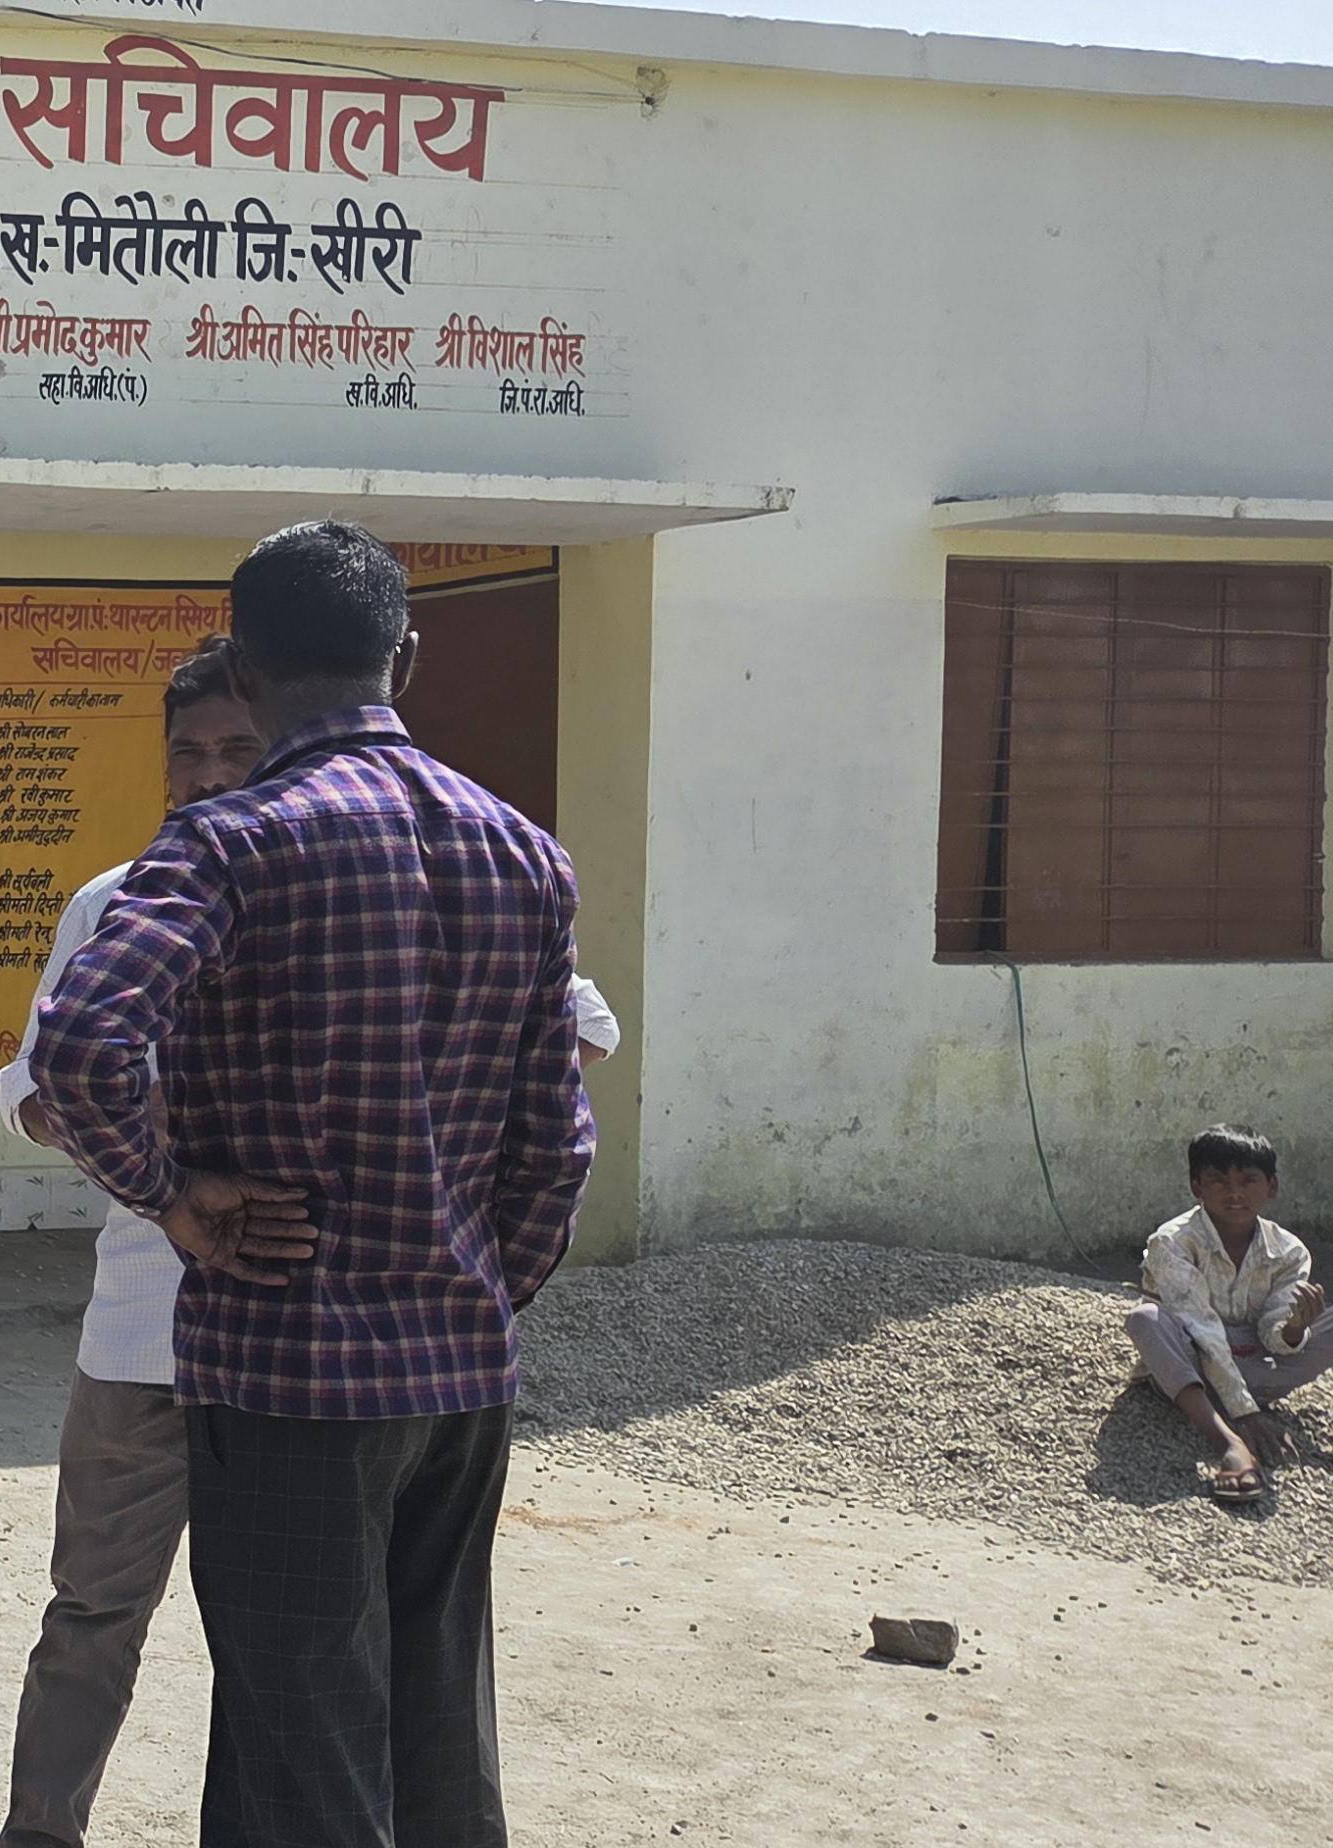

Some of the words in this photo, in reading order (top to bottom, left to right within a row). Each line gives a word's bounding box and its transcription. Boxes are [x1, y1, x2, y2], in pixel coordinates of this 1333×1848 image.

[1, 35, 505, 182] सचिवालय
[10, 300, 84, 360] प्रमोद
[79, 317, 152, 367] कुमार
[186, 303, 219, 361] श्री
[217, 305, 287, 369] अमित
[287, 308, 334, 371] सिंह
[334, 309, 416, 374] परिहार
[435, 312, 467, 369] श्री
[467, 315, 538, 377] विशाल
[538, 316, 586, 380] सिंह
[174, 594, 220, 637] स्मिथ
[0, 804, 17, 823] श्री
